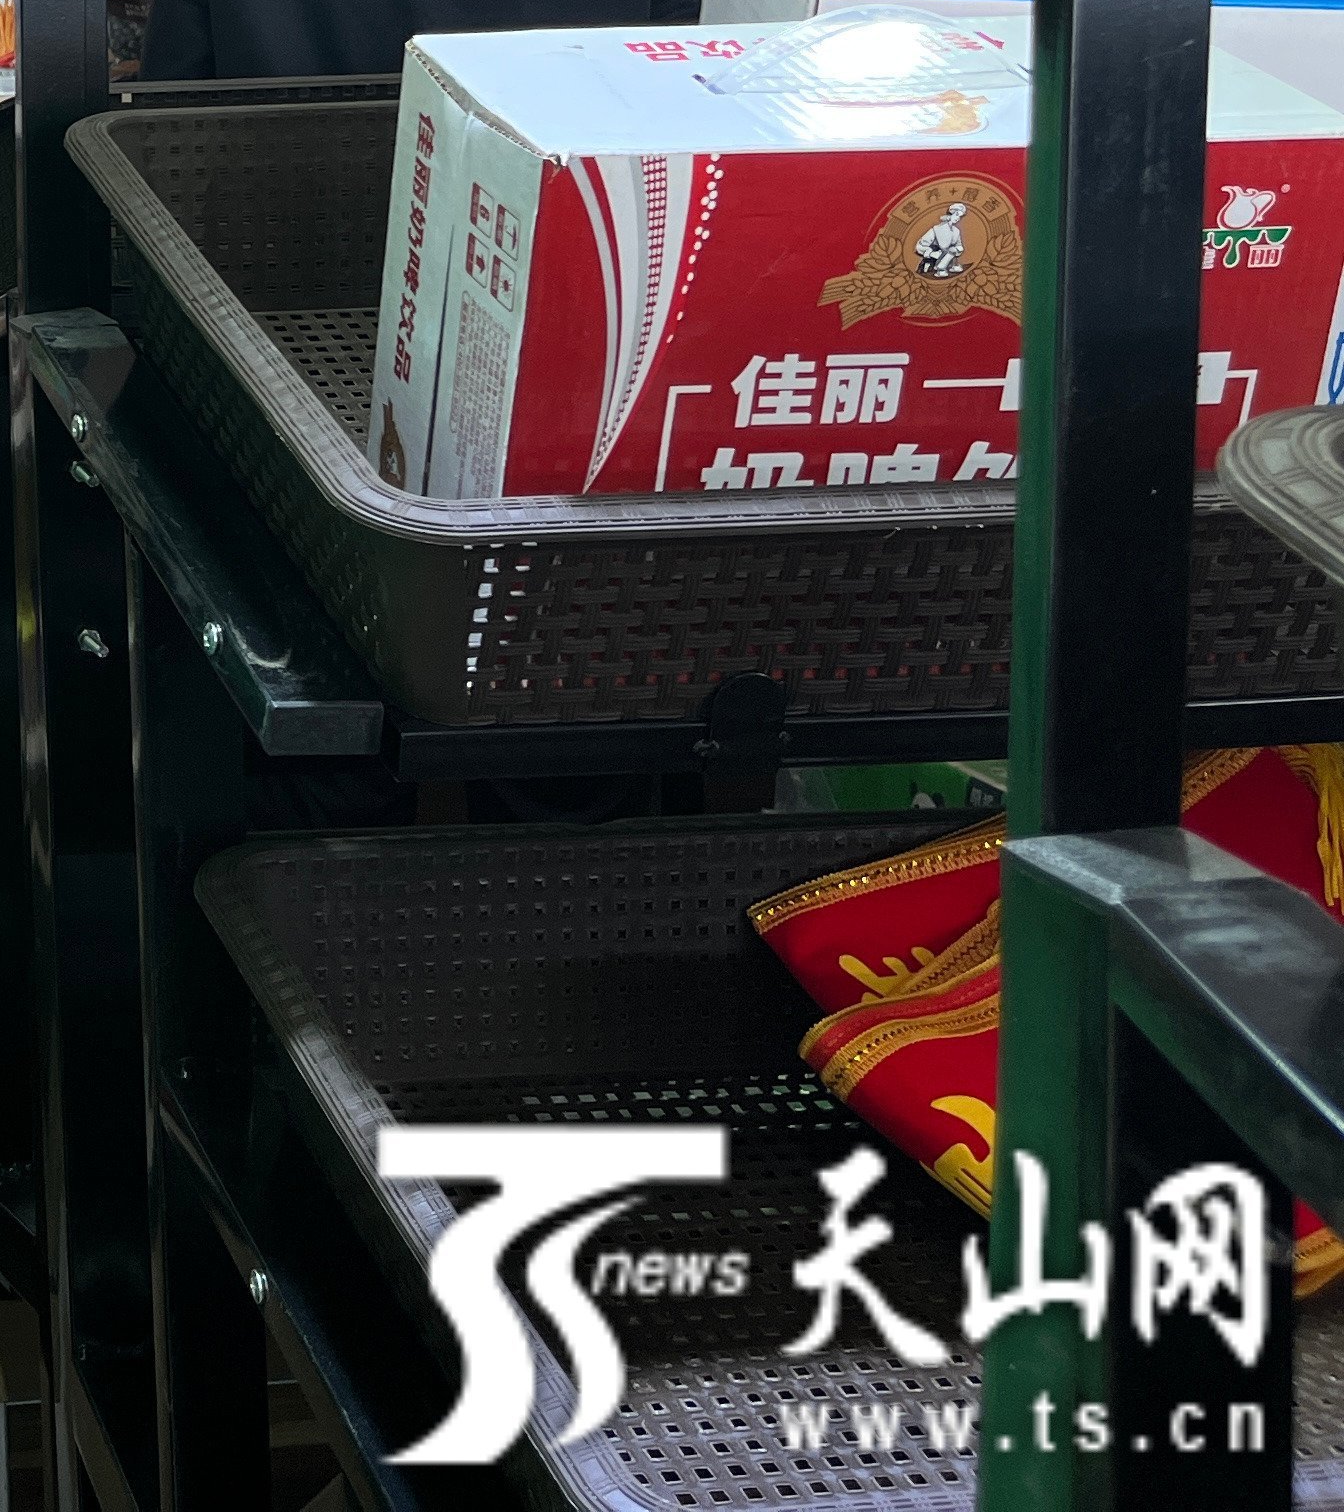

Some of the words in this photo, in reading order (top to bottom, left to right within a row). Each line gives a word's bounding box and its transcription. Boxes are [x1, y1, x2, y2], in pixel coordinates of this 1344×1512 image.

[393, 112, 436, 386] 佳丽奶啤饮品
[732, 352, 911, 427] 佳丽
